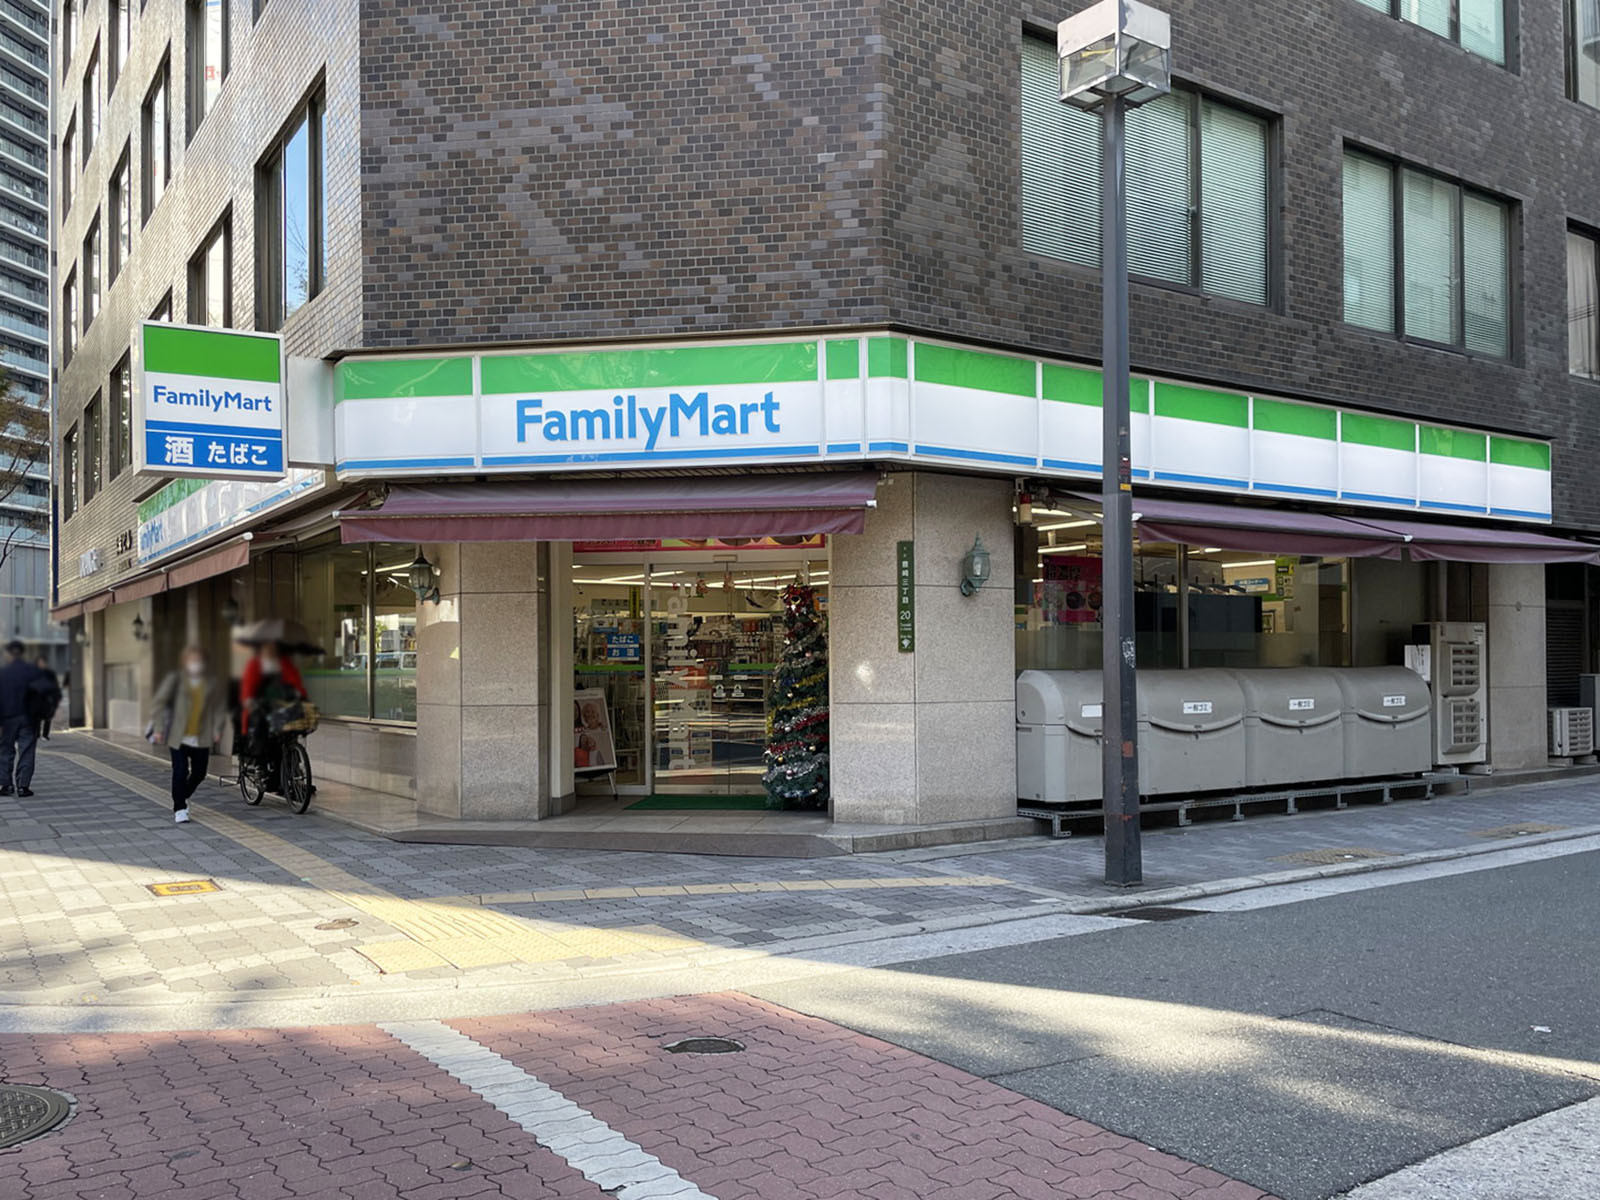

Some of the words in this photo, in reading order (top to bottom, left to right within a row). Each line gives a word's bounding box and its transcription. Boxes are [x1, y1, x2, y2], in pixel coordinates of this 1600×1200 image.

[153, 385, 272, 412] FamilyMart
[516, 391, 780, 451] FamilyMart
[164, 435, 194, 464] 酒
[208, 441, 268, 465] たばこ
[900, 610, 911, 620] 20
[611, 635, 635, 644] たばこ
